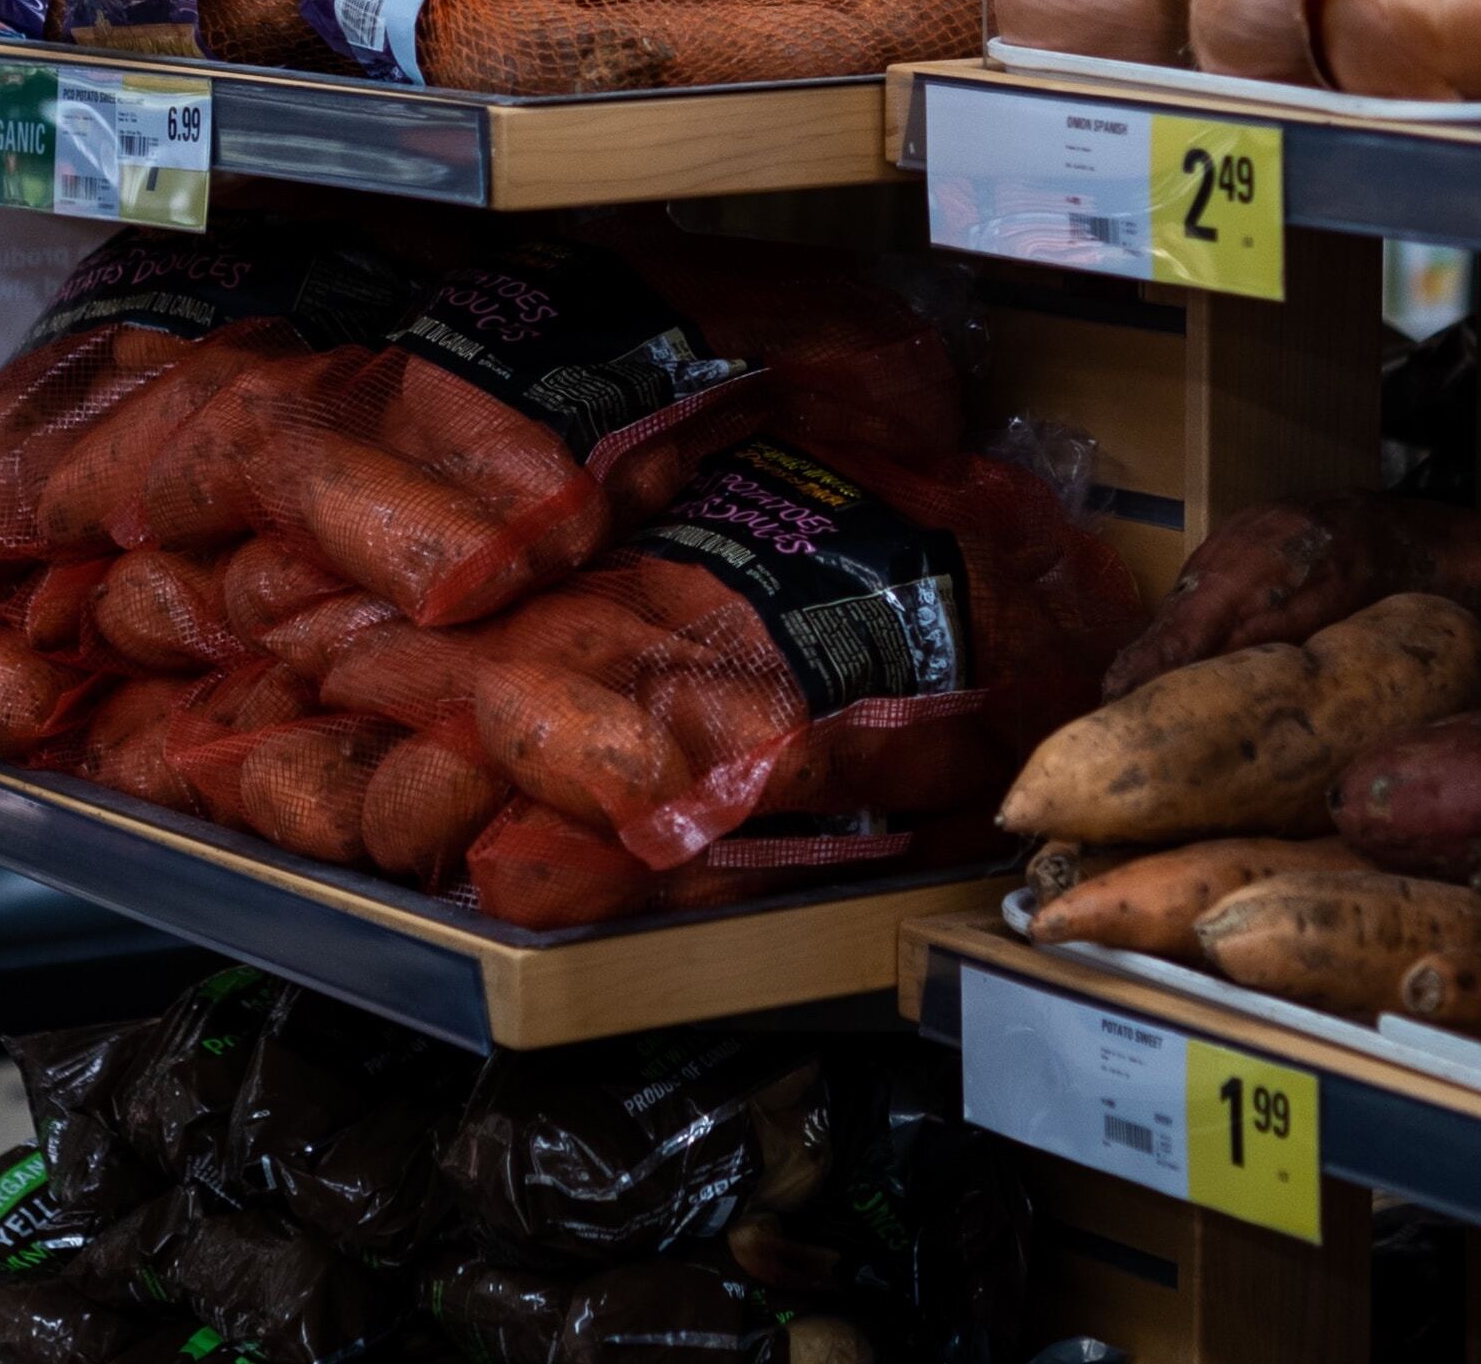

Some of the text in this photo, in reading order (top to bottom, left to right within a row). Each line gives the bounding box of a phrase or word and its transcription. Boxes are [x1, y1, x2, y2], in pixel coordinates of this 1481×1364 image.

[76, 89, 100, 102] POTATO
[167, 106, 201, 142] 6.99
[1066, 115, 1128, 136] ONION SPANISH
[129, 250, 253, 290] DOUCES
[715, 471, 841, 536] POTATOES
[1101, 1019, 1163, 1050] POTATO SWEET
[622, 1076, 683, 1118] PRODU
